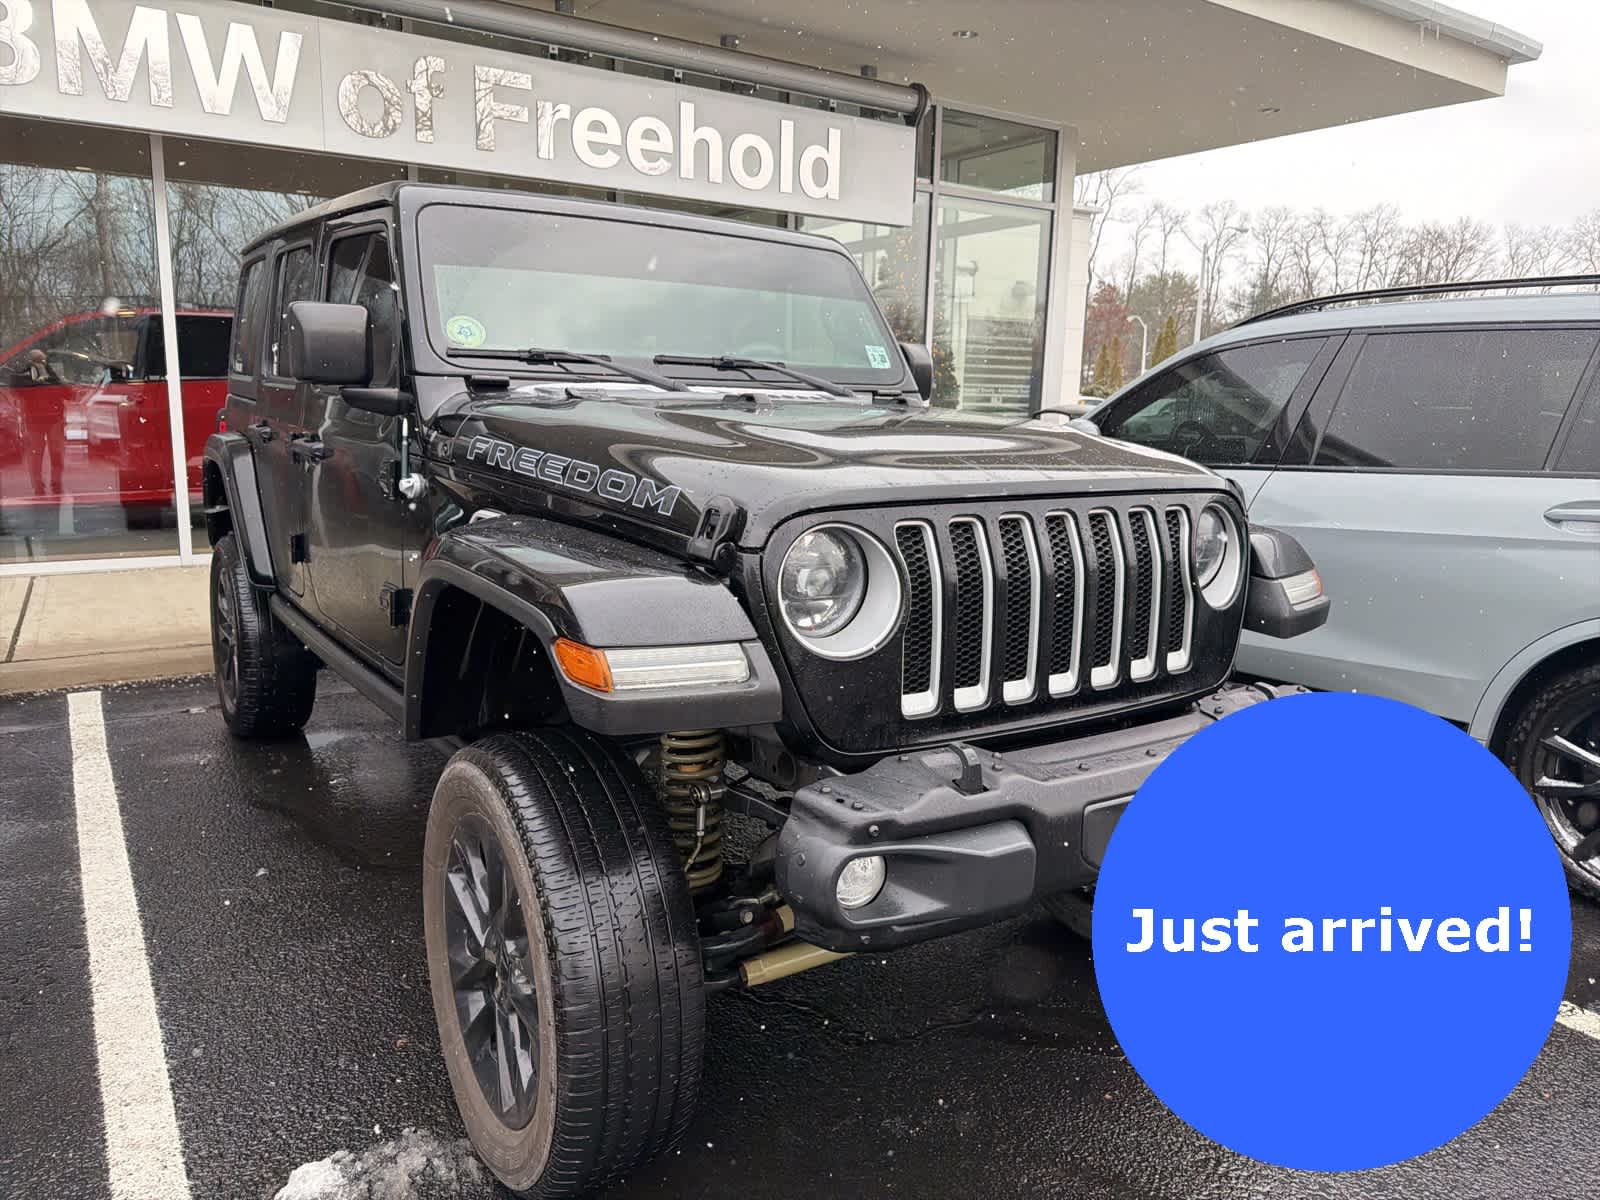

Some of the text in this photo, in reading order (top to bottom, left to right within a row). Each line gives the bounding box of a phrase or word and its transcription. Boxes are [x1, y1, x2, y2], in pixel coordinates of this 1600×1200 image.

[337, 56, 445, 143] of
[474, 64, 840, 200] Freehold
[466, 435, 681, 516] FREEDOM
